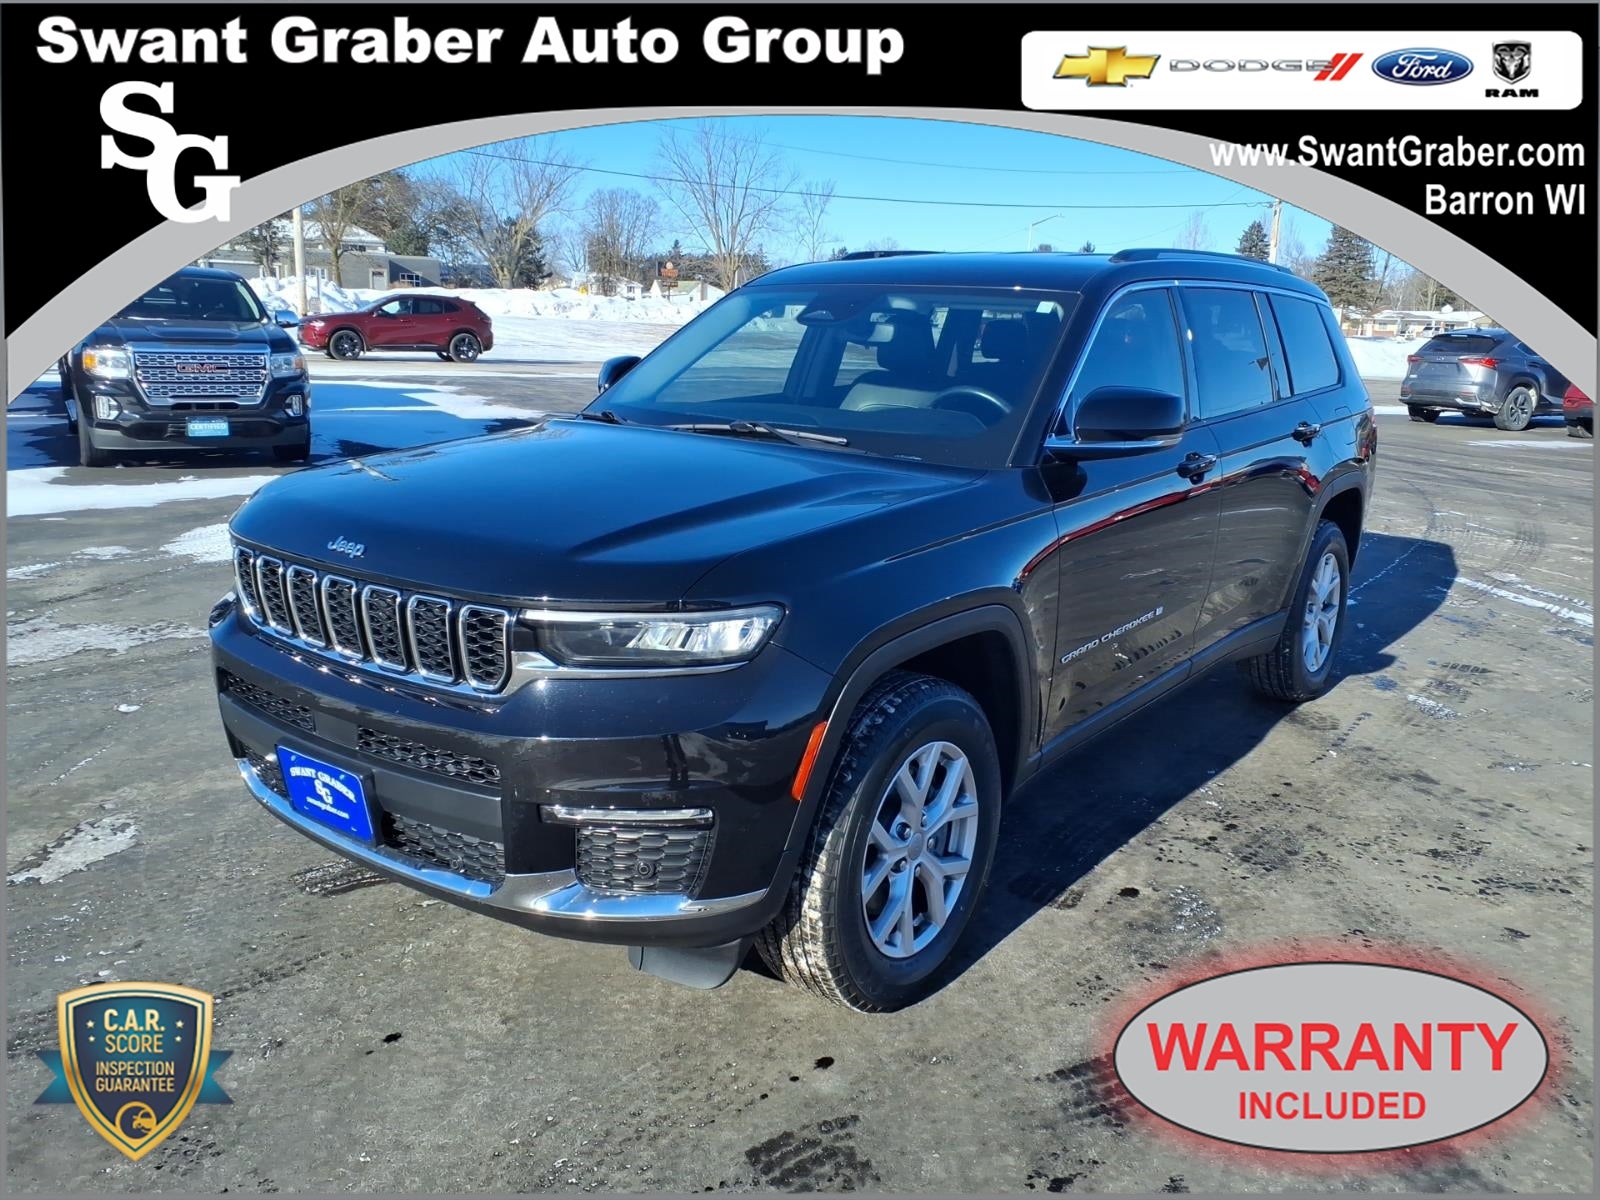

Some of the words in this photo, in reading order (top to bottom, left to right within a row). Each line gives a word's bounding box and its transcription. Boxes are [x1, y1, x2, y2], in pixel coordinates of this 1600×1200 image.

[327, 535, 365, 558] Jeep
[1061, 639, 1100, 664] GRAND
[1101, 611, 1156, 642] CHEROKEE
[290, 766, 318, 778] SWANT
[317, 771, 357, 804] GRABER
